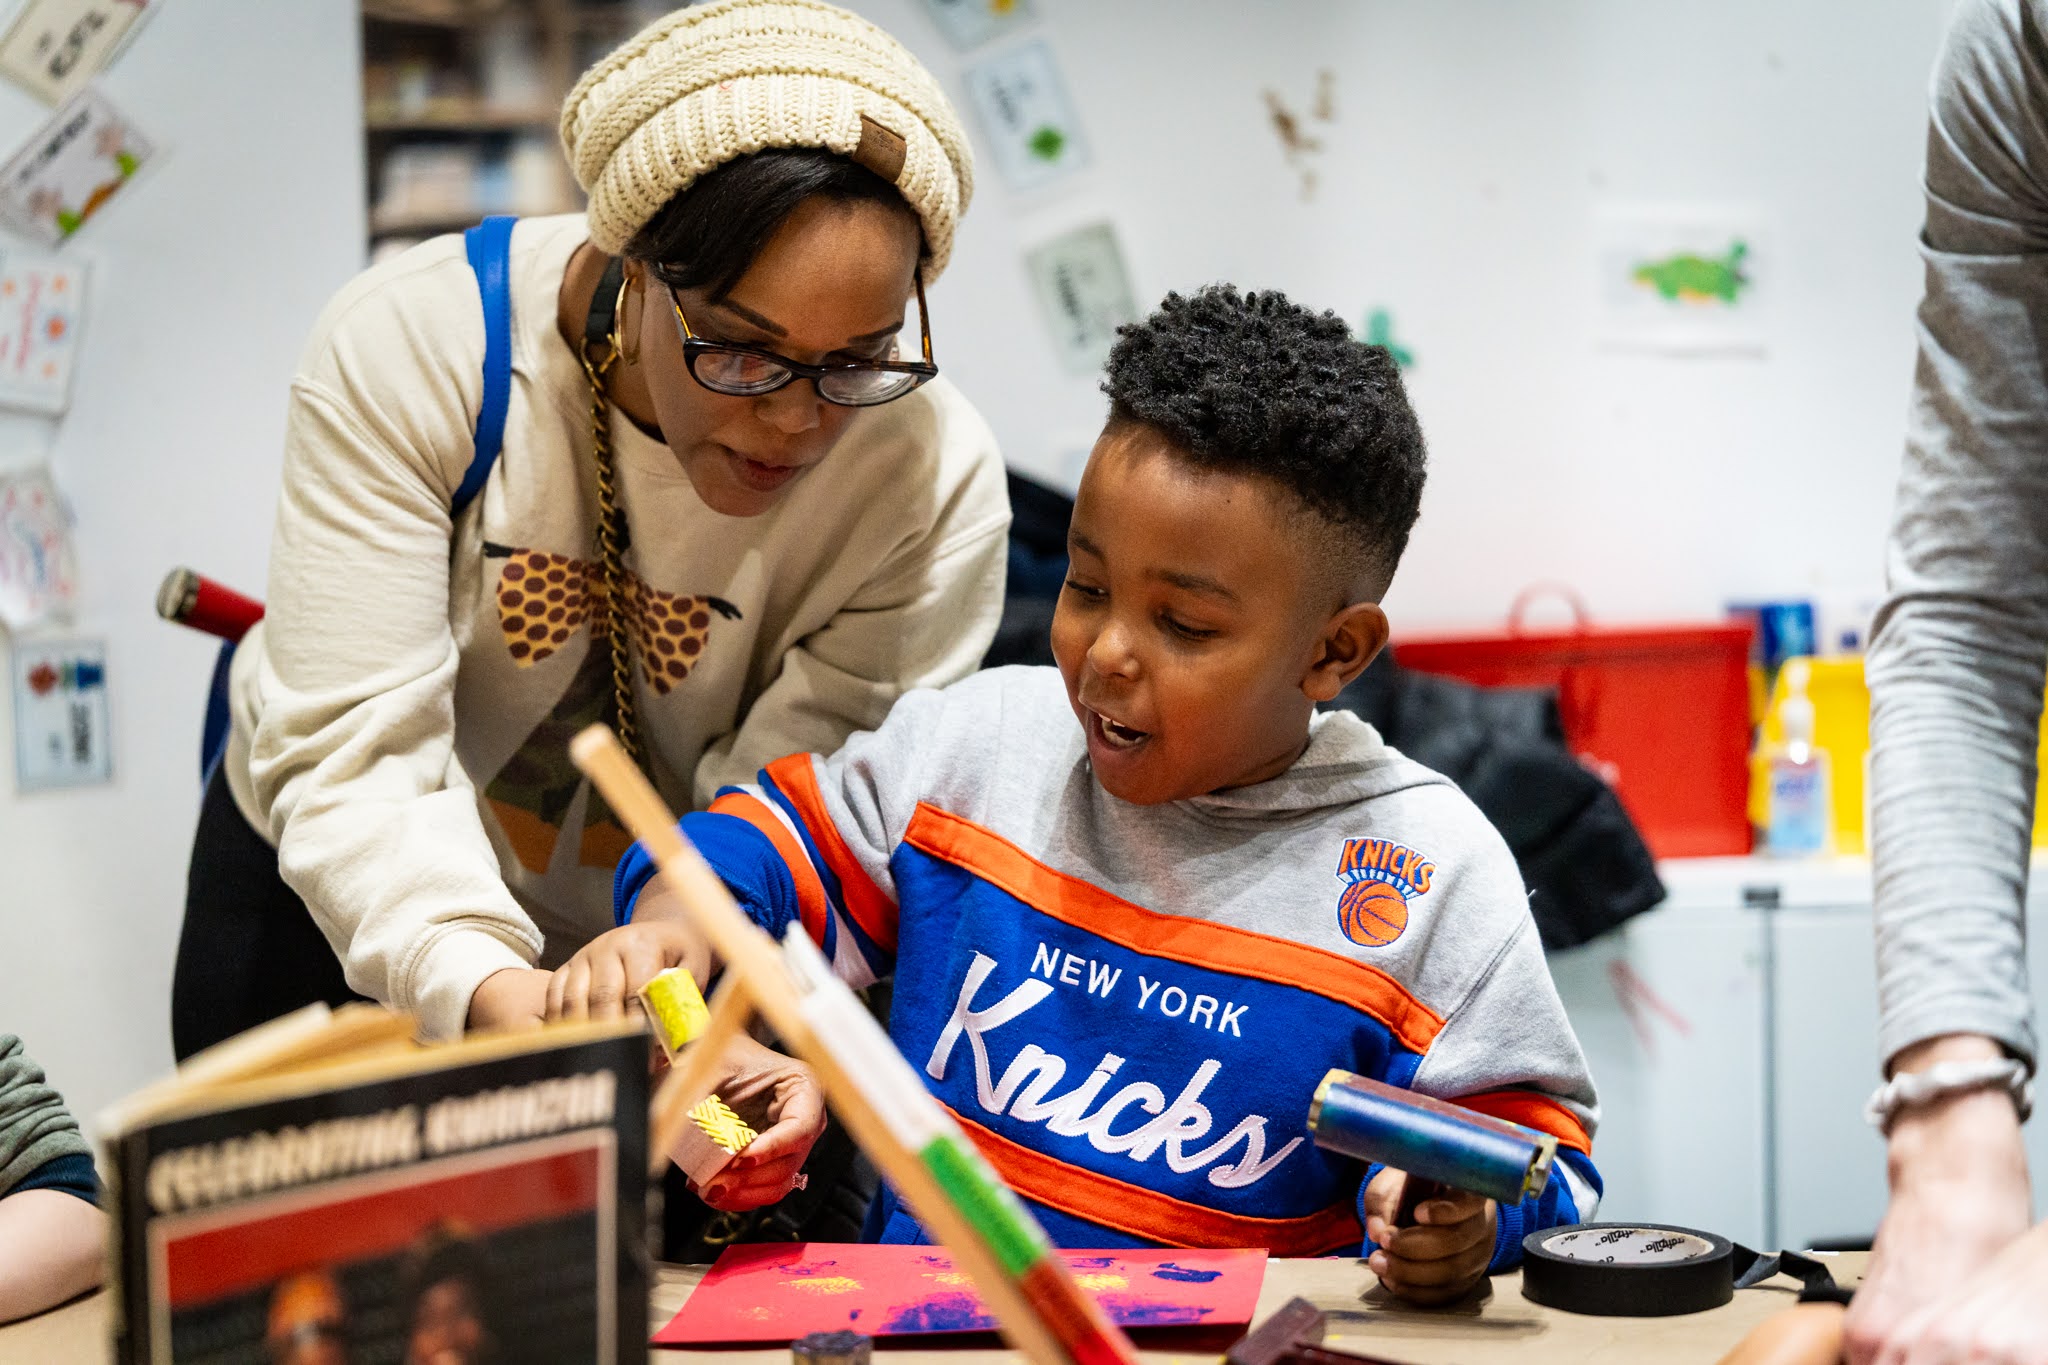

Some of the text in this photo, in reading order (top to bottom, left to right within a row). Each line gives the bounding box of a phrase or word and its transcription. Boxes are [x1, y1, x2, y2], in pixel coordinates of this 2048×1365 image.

[1338, 838, 1436, 894] KNICKS
[1031, 942, 1249, 1037] NEW YORK
[925, 950, 1304, 1188] Knicks
